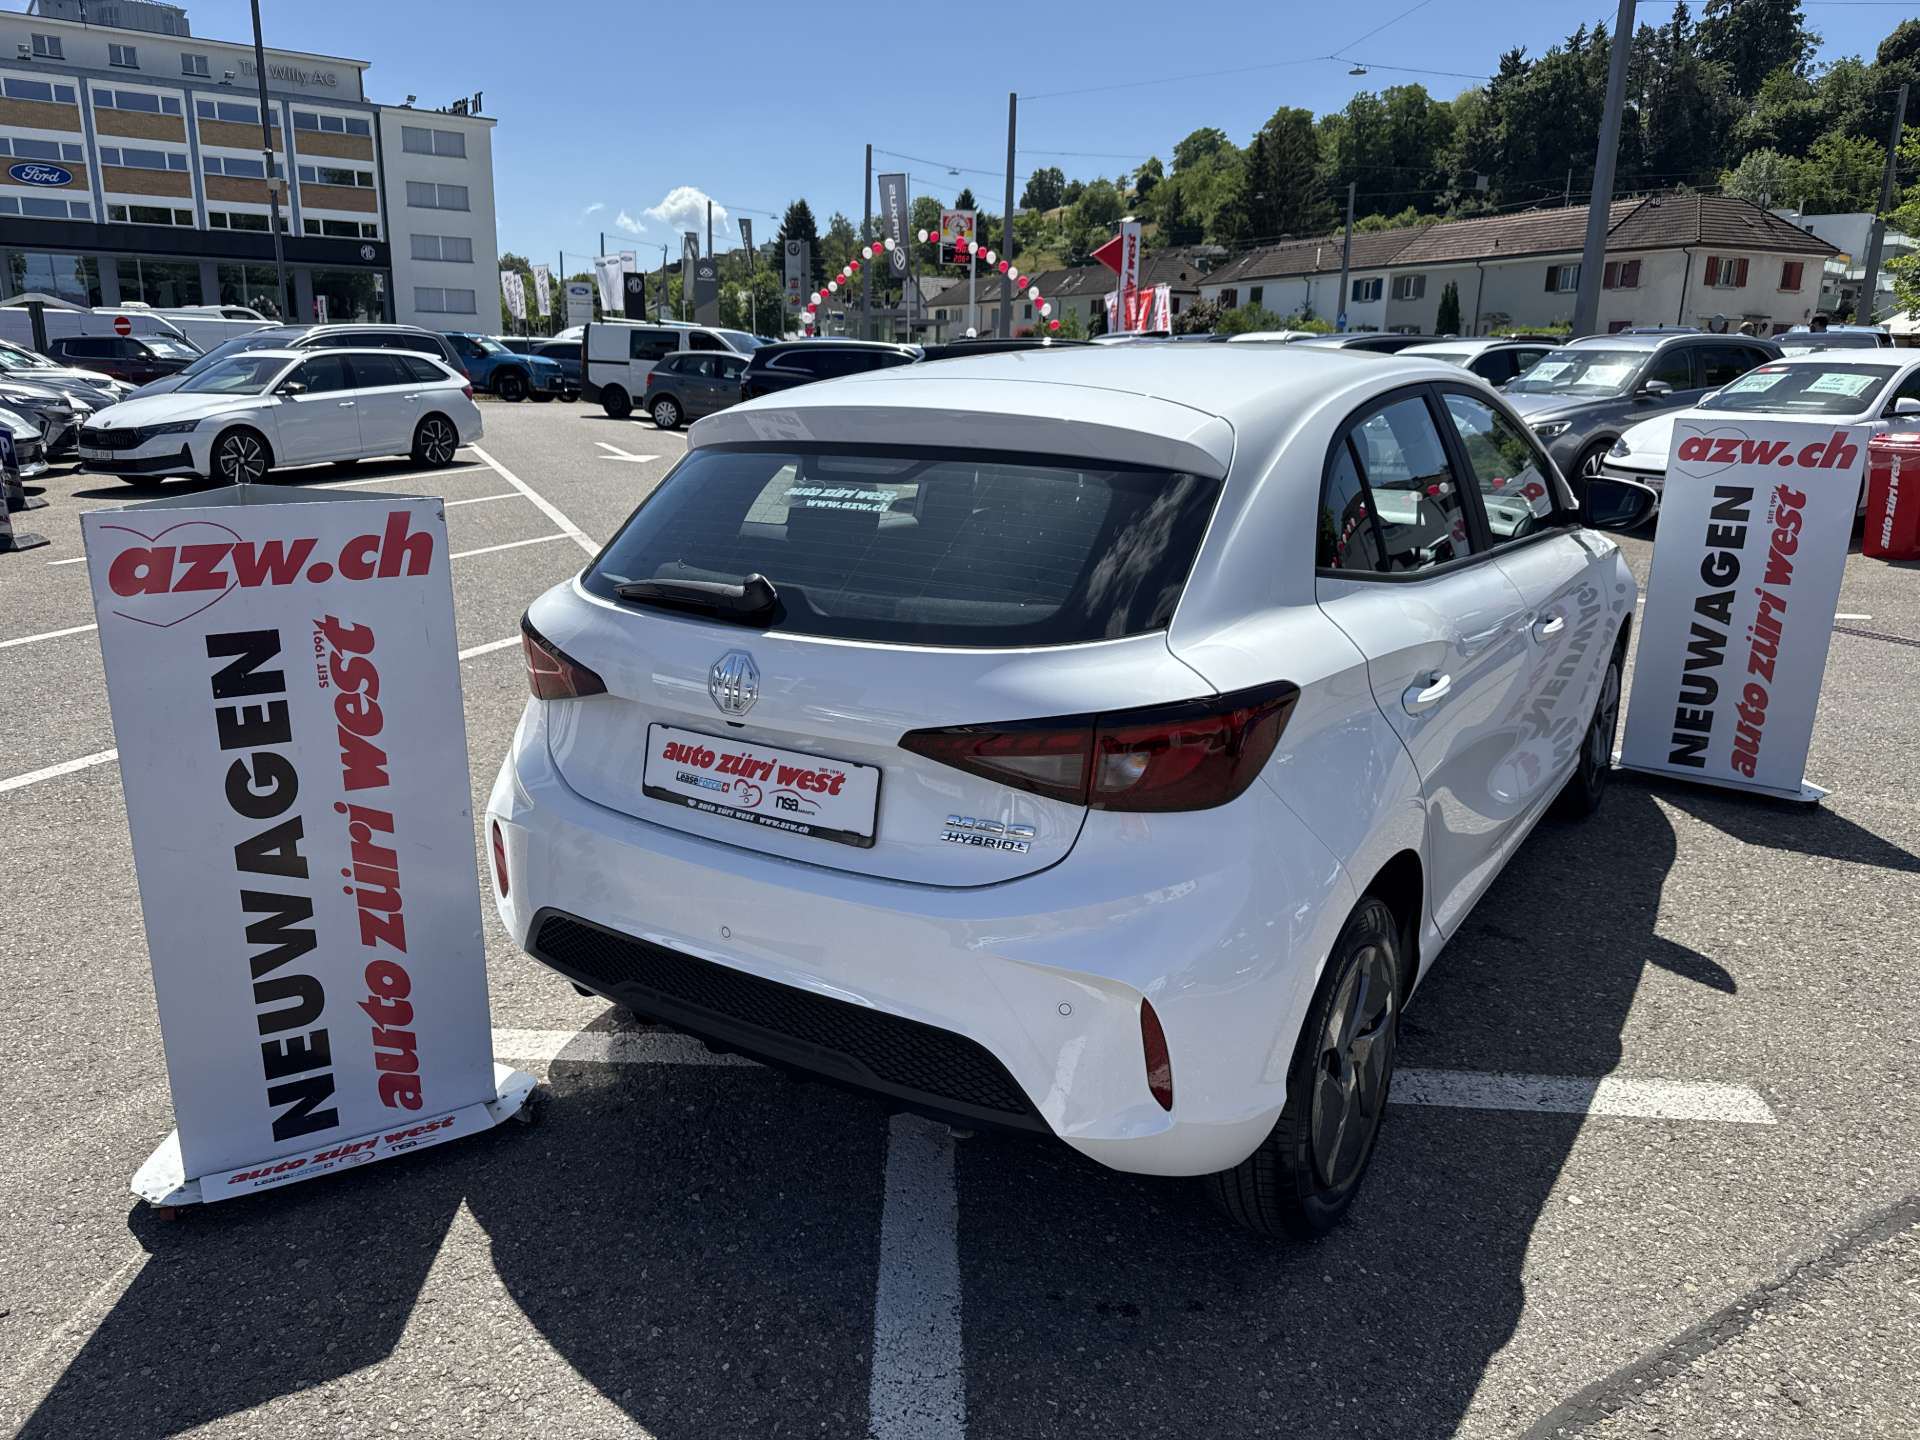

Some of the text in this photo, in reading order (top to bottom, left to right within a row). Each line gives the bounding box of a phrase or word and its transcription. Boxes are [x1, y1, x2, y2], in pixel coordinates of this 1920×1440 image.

[269, 64, 306, 86] Willy
[312, 70, 337, 88] AG
[21, 165, 61, 182] Ford
[361, 245, 375, 260] MG
[627, 277, 643, 293] MG
[1678, 431, 1858, 470] azw.ch
[784, 486, 898, 502] auto züri west
[806, 499, 889, 513] www.azw.ch
[1767, 490, 1778, 524] SEIT 1991
[1885, 485, 1899, 518] züri
[1881, 516, 1893, 549] auto
[108, 511, 434, 597] azw.ch
[1668, 485, 1754, 768] NEUWAGEN
[1731, 484, 1806, 778] auto züri west
[313, 630, 330, 688] SEIT 1991
[662, 741, 846, 796] auto züri west
[698, 802, 716, 812] auto
[735, 811, 756, 821] west
[776, 796, 800, 812] nsa
[312, 614, 423, 1110] auto züri west
[206, 629, 340, 1142] NEUWAGEN
[227, 1115, 456, 1185] auto züri west
